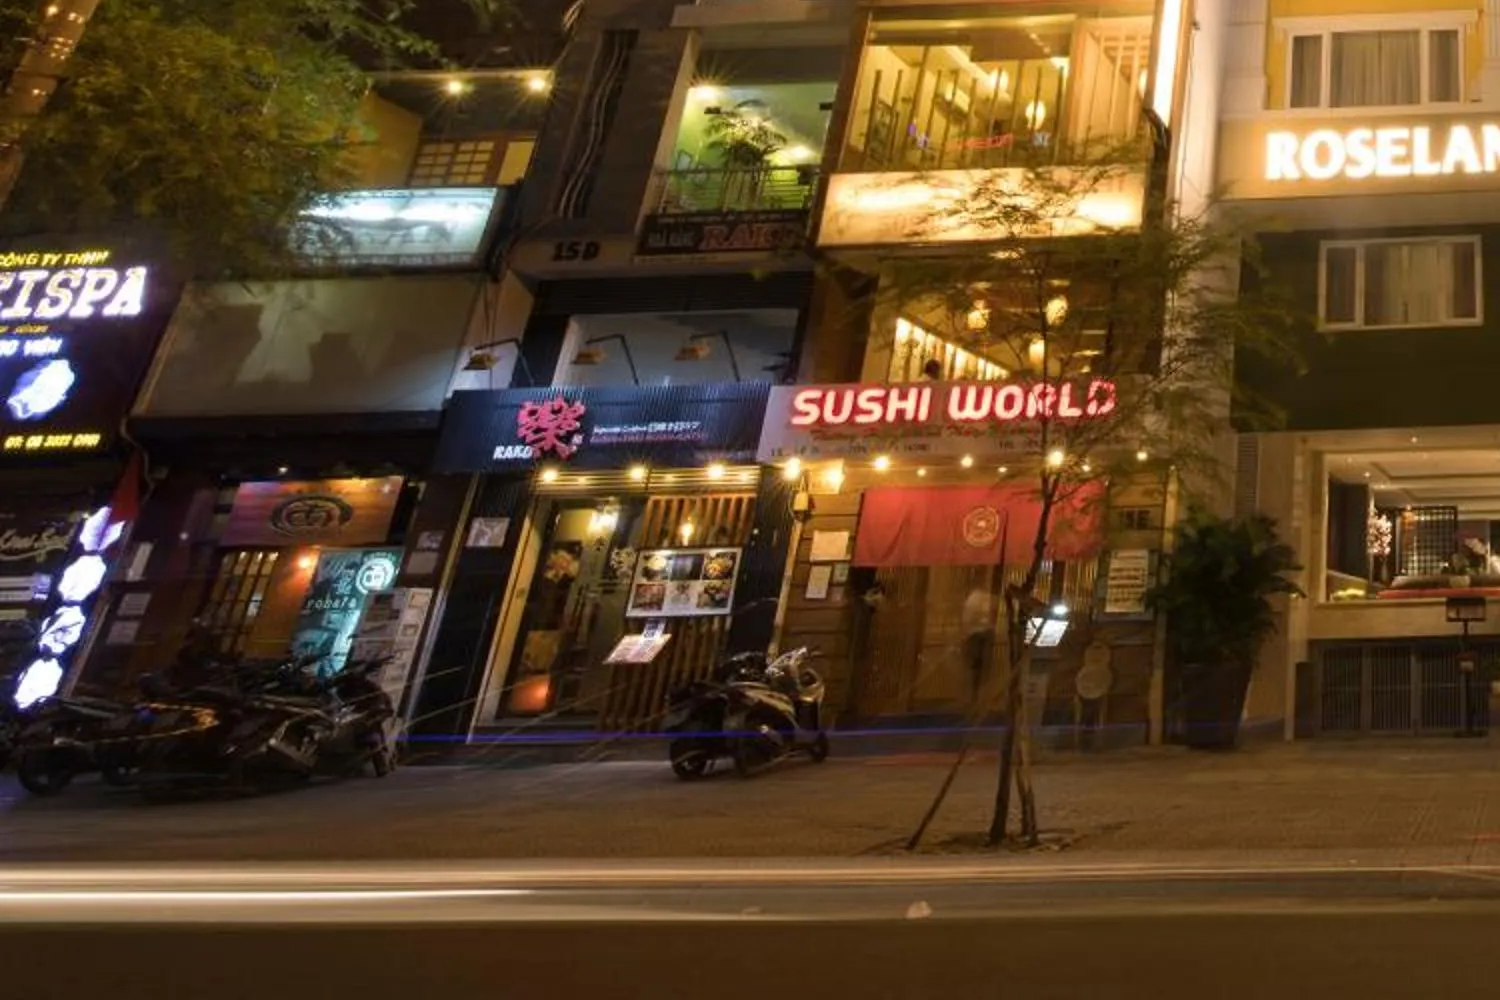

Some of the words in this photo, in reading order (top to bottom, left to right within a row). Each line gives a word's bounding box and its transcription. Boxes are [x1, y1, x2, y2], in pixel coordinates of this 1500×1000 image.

[791, 386, 931, 425] SUSHI
[949, 379, 1117, 421] WORLD
[493, 446, 533, 459] RAKO
